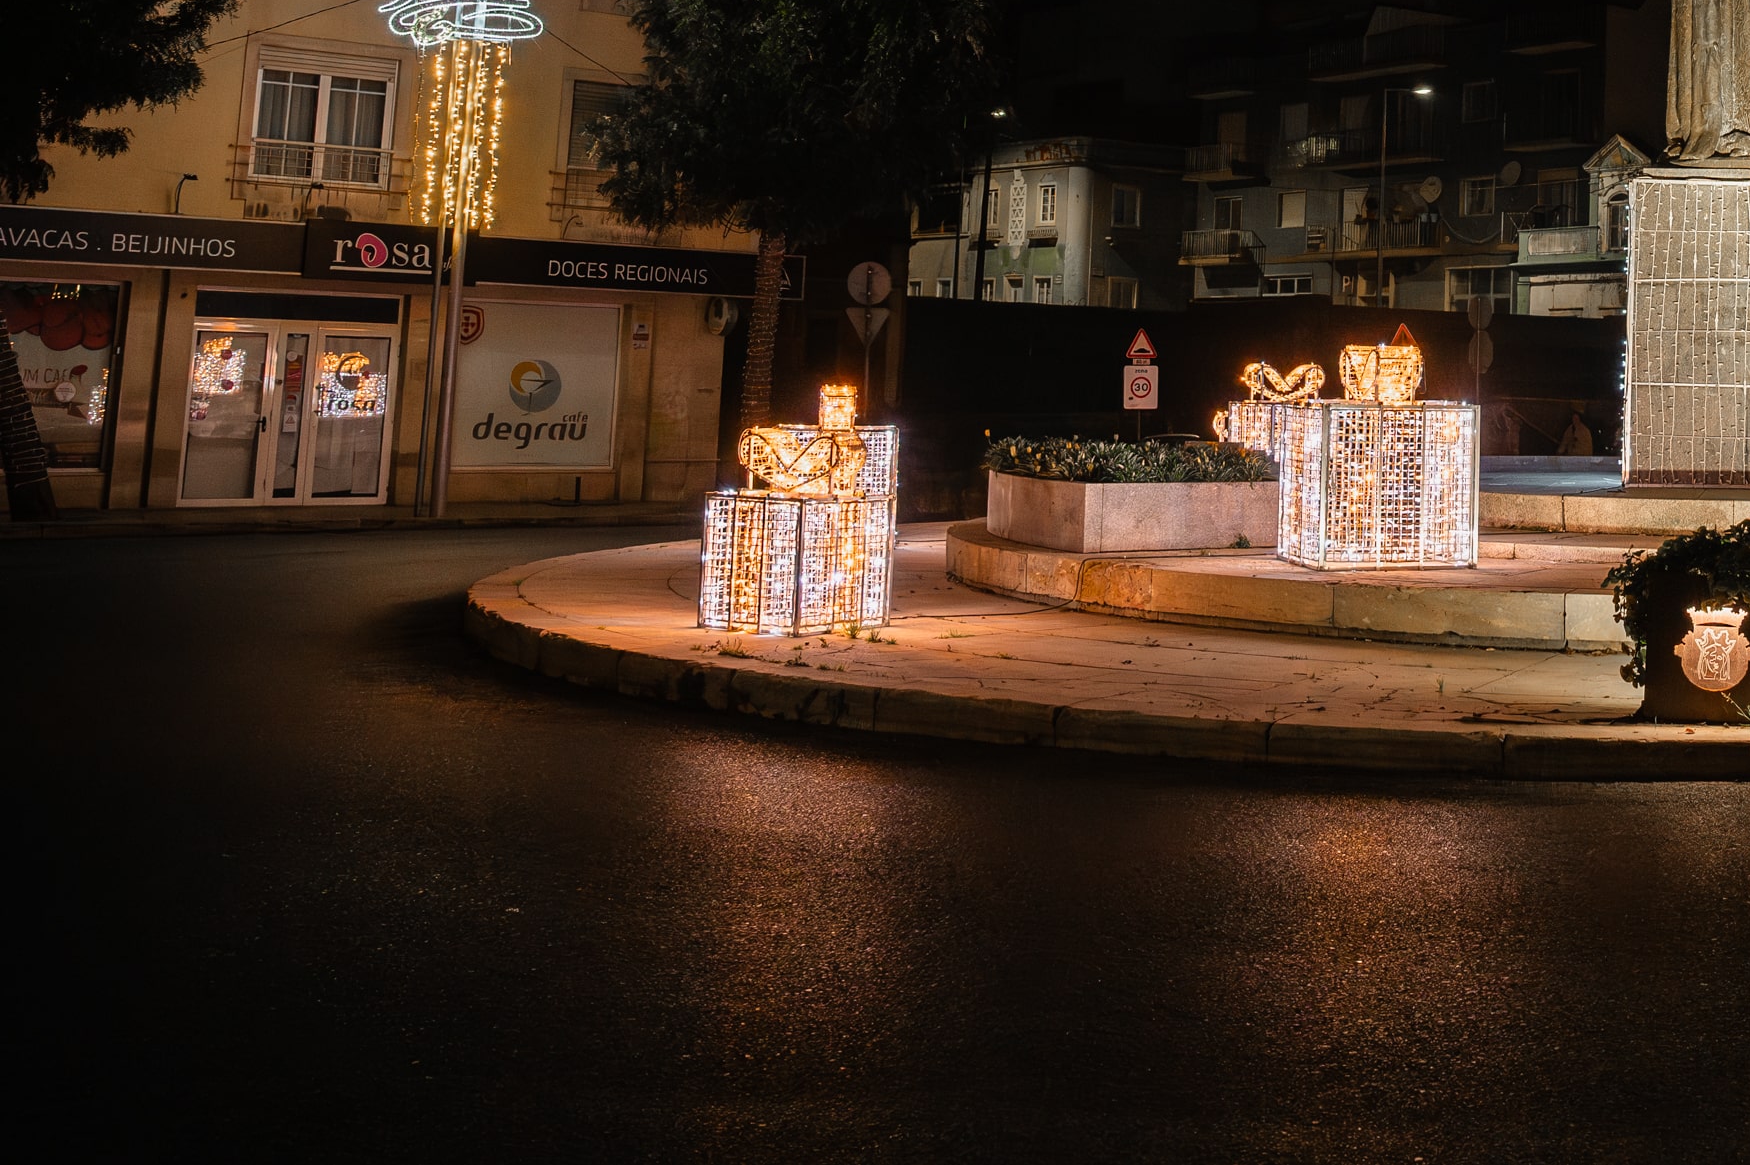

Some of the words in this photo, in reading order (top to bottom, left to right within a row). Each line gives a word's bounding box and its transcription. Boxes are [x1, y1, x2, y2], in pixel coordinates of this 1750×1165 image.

[111, 233, 237, 259] BEIJINHOS
[331, 232, 432, 269] rosa
[547, 259, 608, 280] DOCES
[614, 262, 710, 286] REGIONAIS
[1134, 382, 1149, 392] 30
